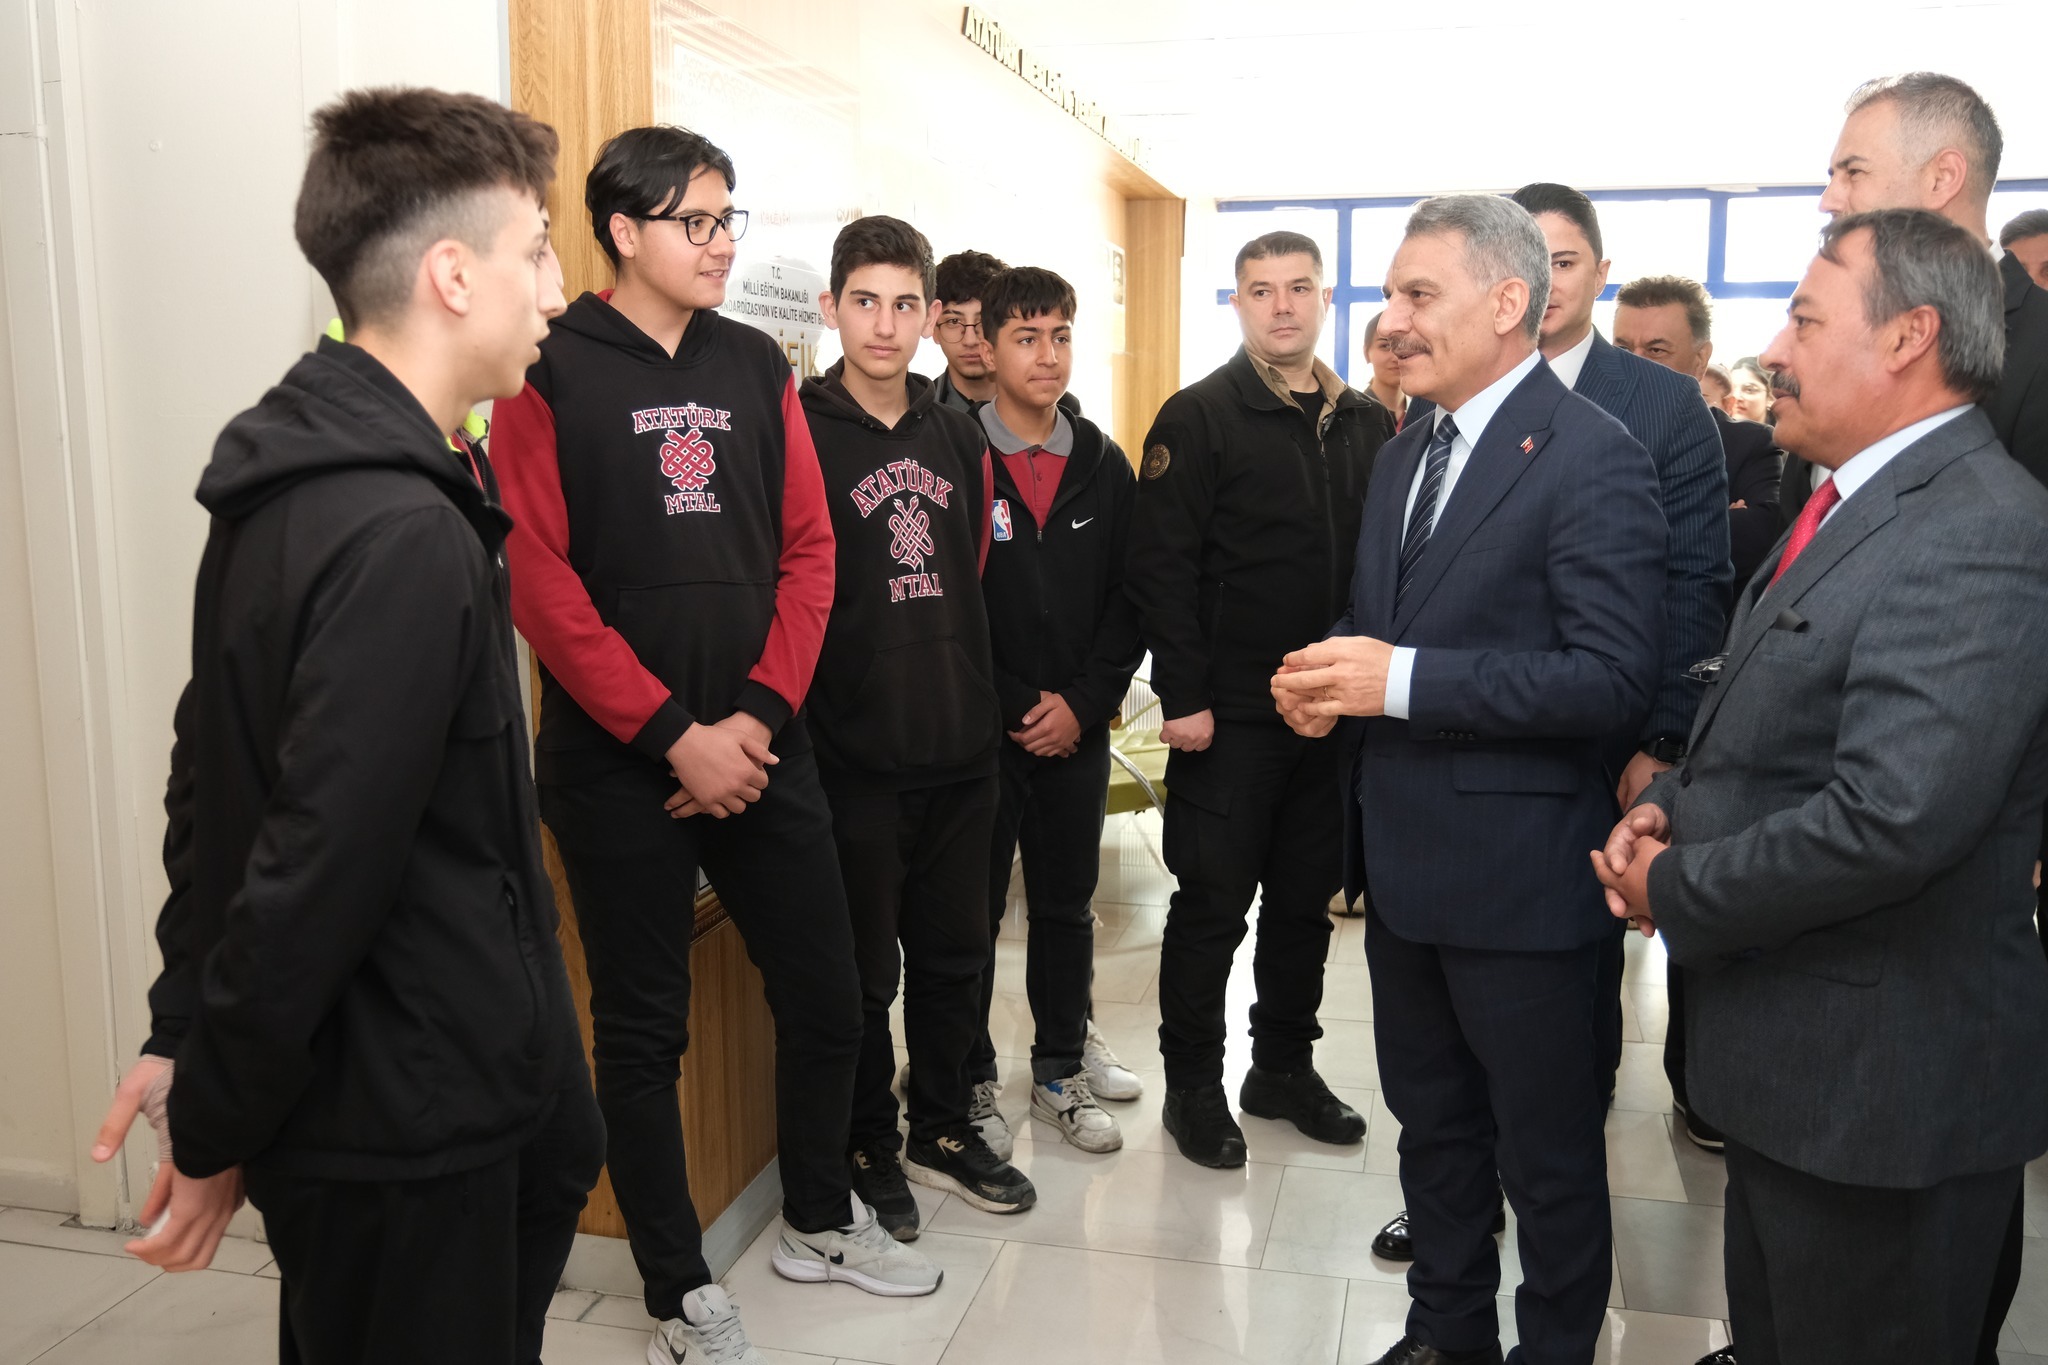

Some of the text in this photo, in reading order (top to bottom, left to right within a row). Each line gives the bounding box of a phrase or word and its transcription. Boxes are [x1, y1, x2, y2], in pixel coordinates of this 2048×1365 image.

[771, 266, 783, 280] T.C.
[743, 279, 809, 304] MİLLİ EĞİTİM BAKANLIĞI
[720, 298, 769, 317] ANDARDİZASYON
[771, 306, 778, 319] VE
[779, 305, 798, 321] KALİTE
[798, 308, 817, 324] HİZMET
[632, 402, 731, 434] ATATÜRK
[849, 457, 953, 518] ATATÜRK
[664, 492, 721, 516] MTAL
[888, 572, 944, 603] MTAL
